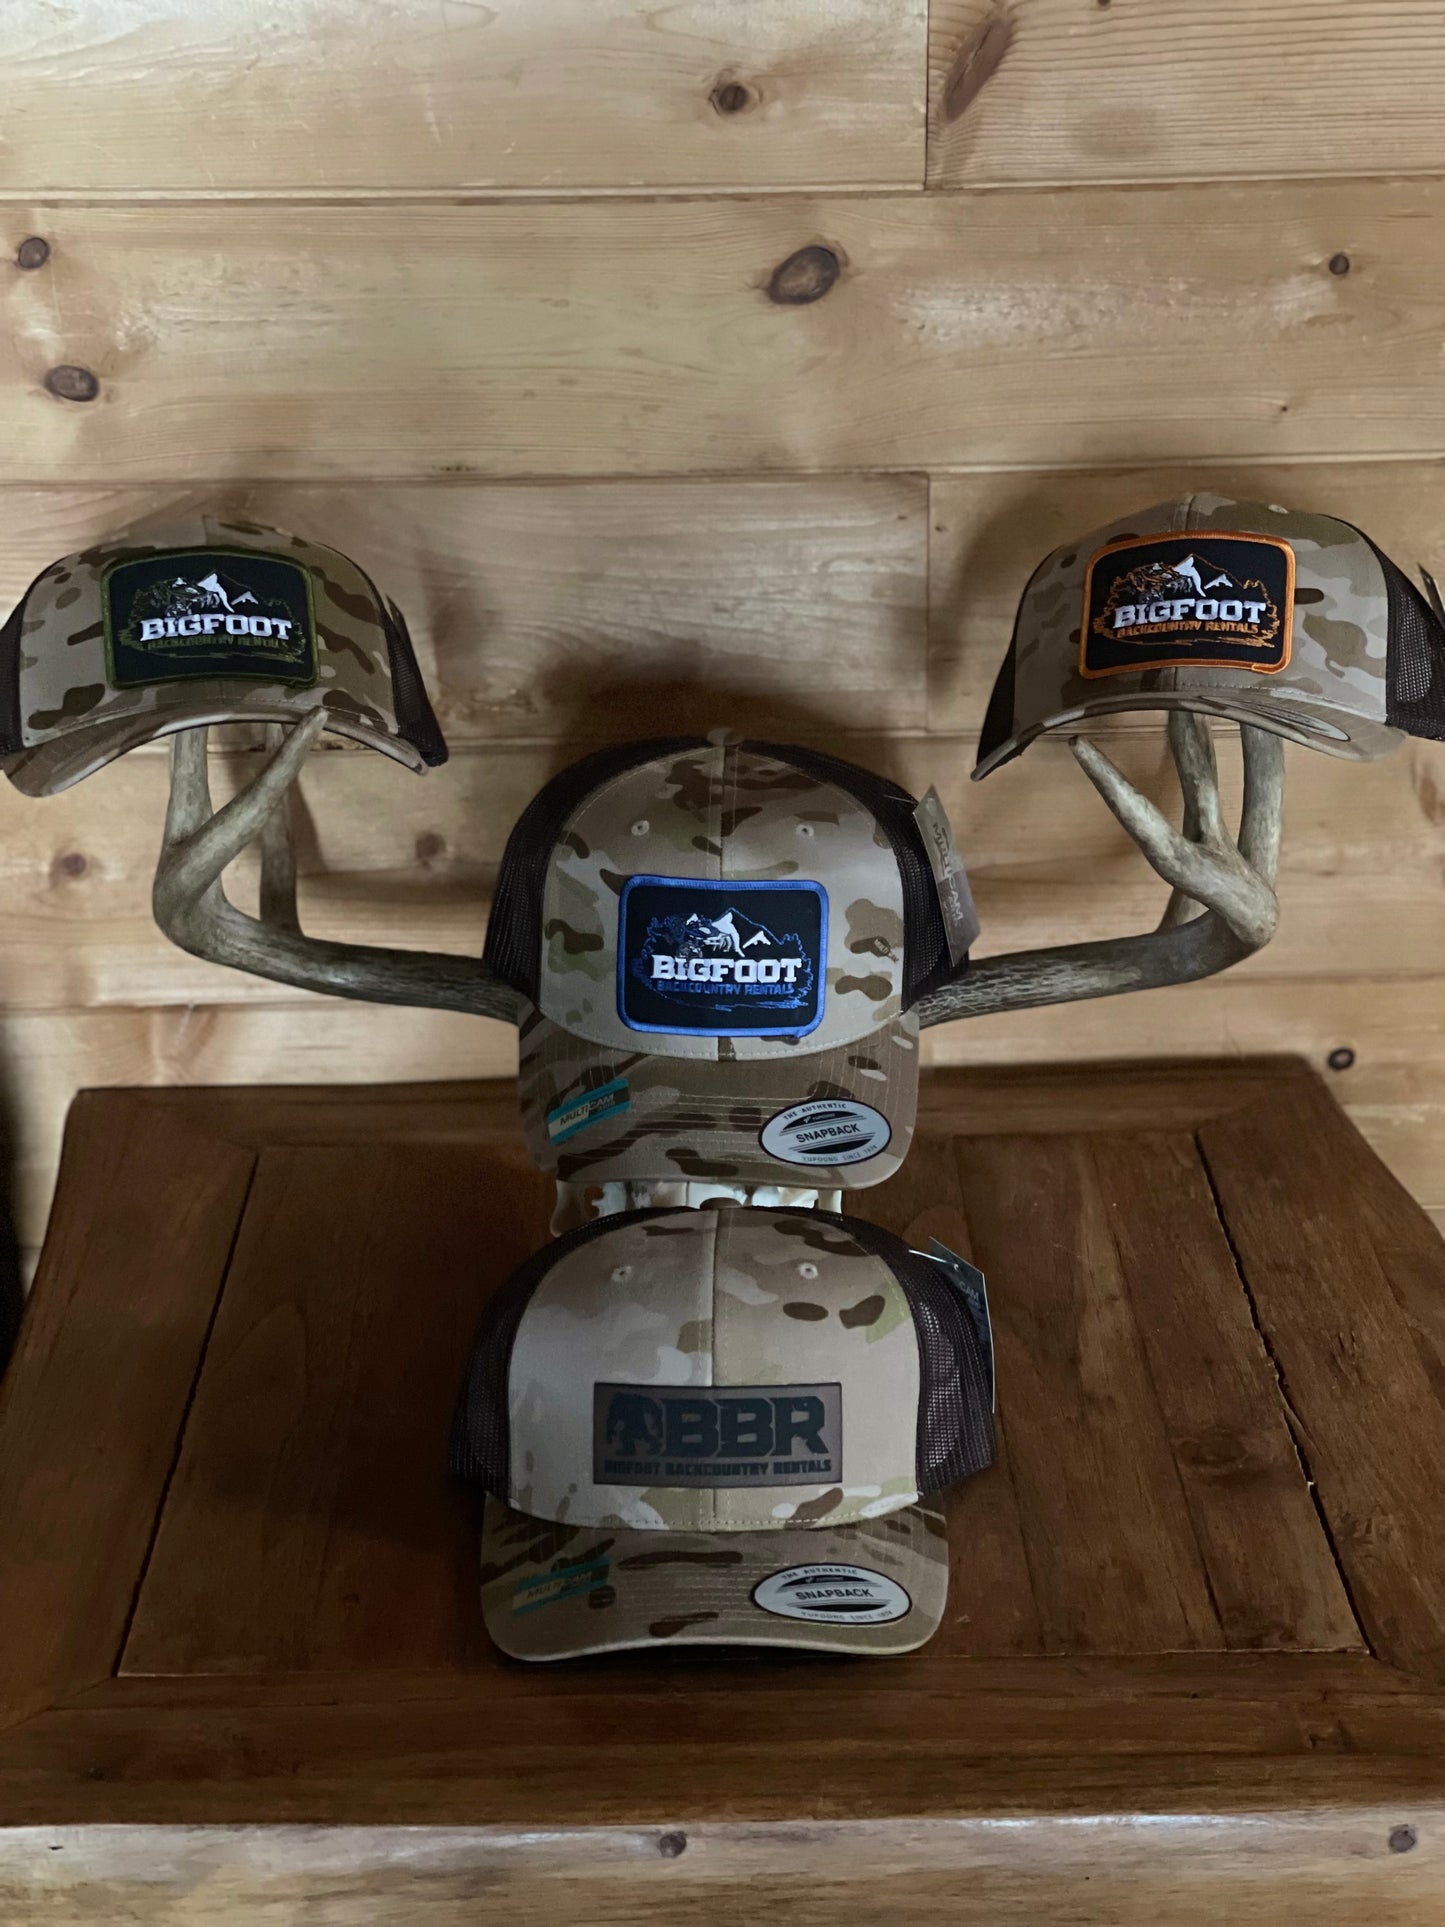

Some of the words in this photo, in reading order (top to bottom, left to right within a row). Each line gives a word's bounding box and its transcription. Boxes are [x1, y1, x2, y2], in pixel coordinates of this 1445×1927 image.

[1112, 598, 1267, 629] BIGFOOT
[139, 613, 293, 642] BIGFOOT
[1204, 621, 1259, 634] RENTALS
[650, 954, 803, 983] BIGFOOT
[744, 982, 794, 996] RENTALS
[783, 1110, 798, 1121] THE
[802, 1103, 847, 1114] AUTHENTIC
[795, 1123, 862, 1143] SNAPBACK
[663, 1395, 830, 1458] BBR
[604, 1459, 659, 1474] BIGFOOT
[665, 1461, 769, 1477] BACKCOUNTRY
[773, 1459, 832, 1475] RENTALS
[795, 1587, 874, 1600] SNAPBACK
